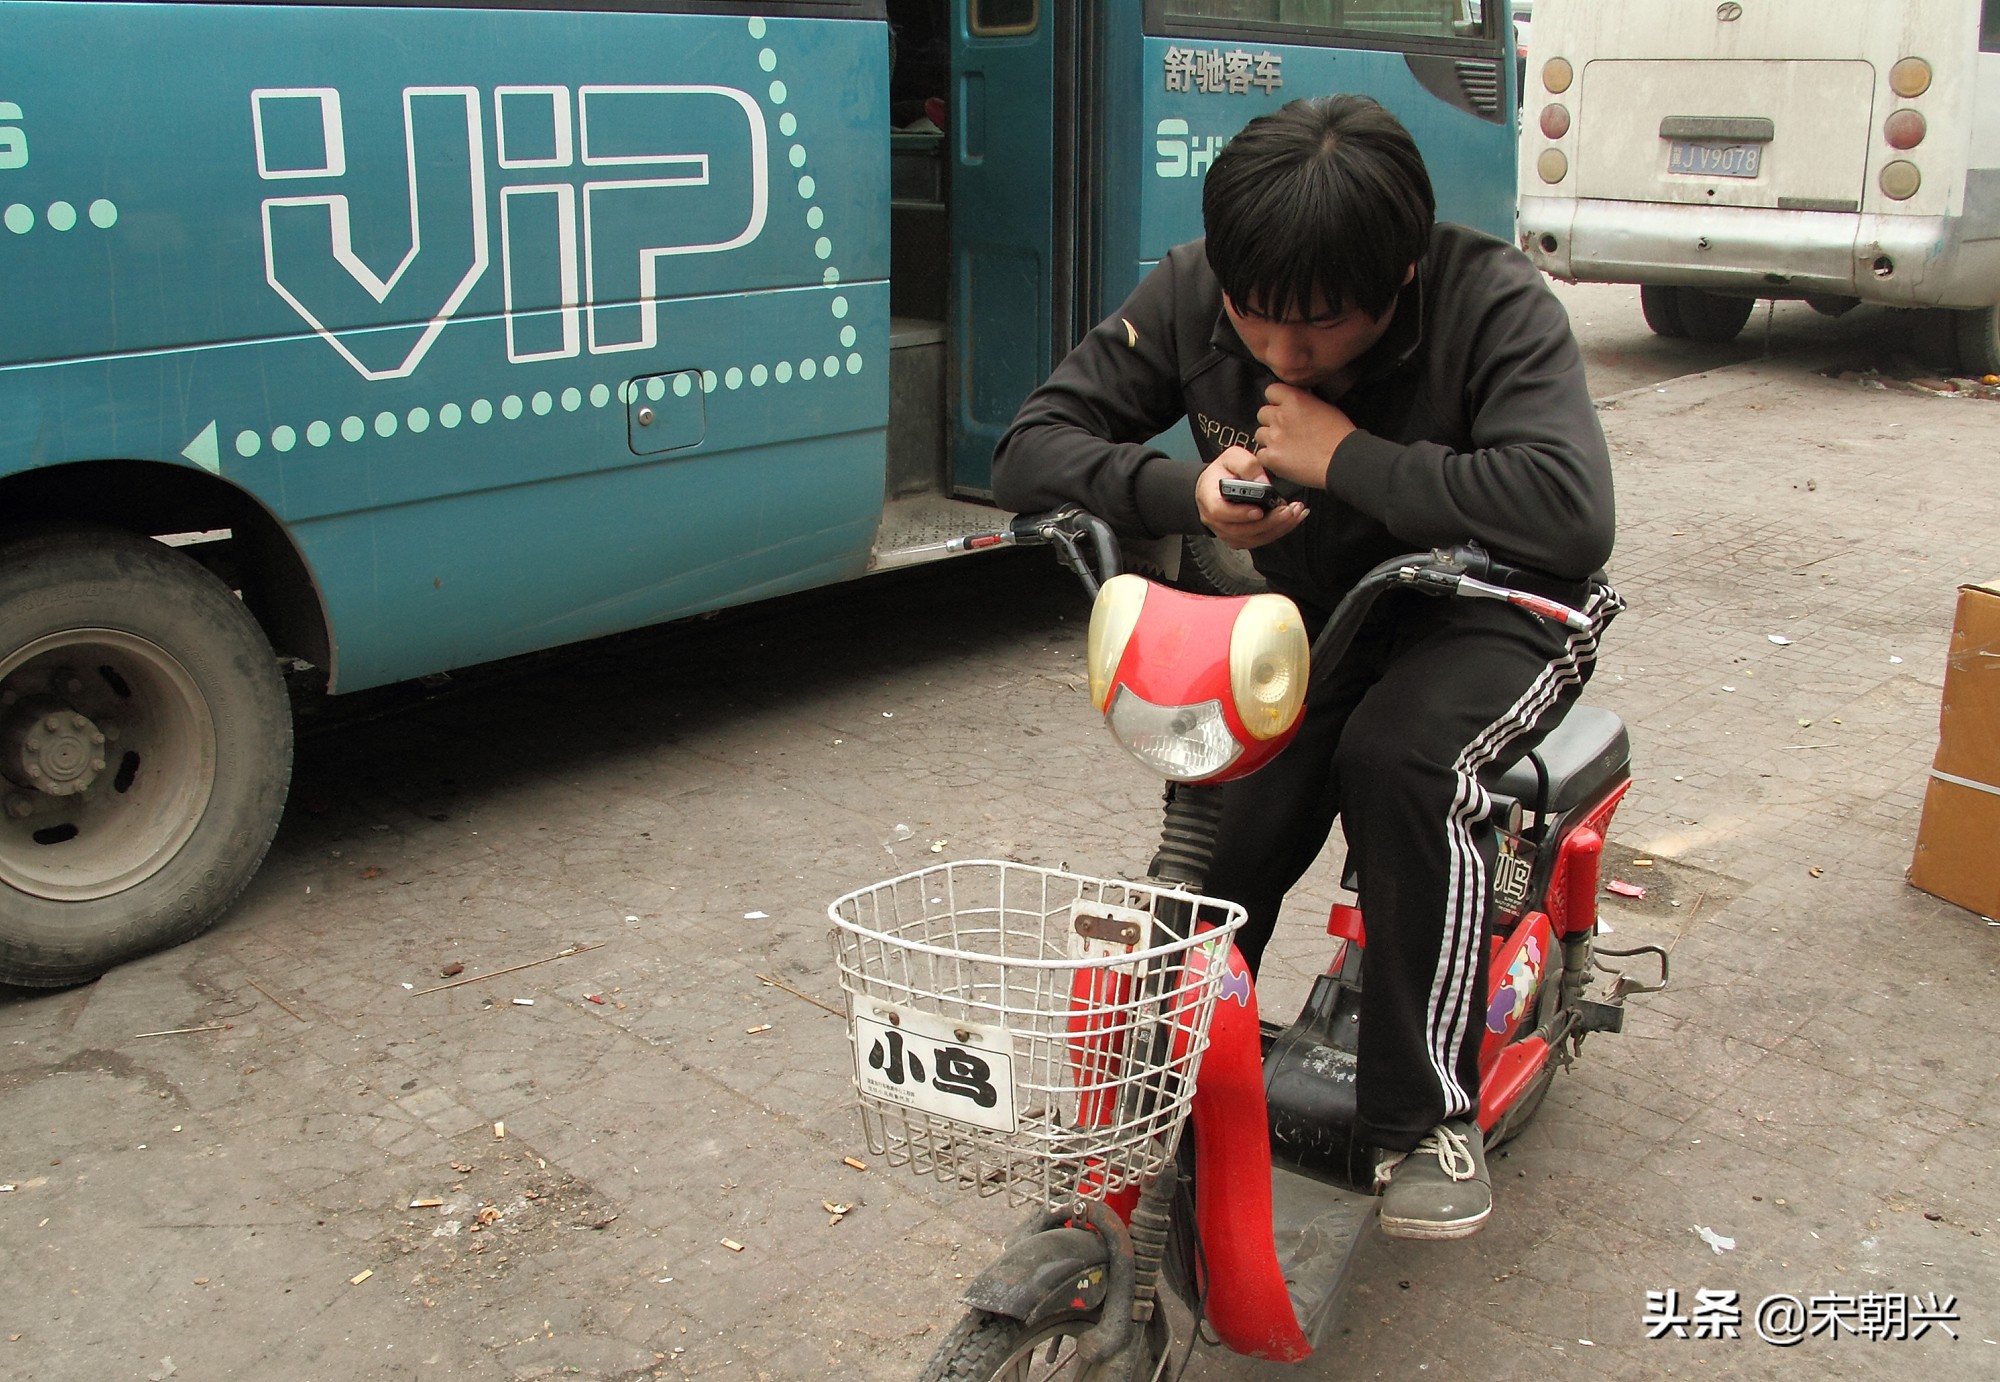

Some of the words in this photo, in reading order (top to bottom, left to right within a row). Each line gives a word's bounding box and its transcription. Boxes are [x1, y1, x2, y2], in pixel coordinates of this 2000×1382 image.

[1164, 46, 1282, 94] 舒驰客车
[250, 84, 769, 382] VIP
[868, 1030, 998, 1109] 小鸟
